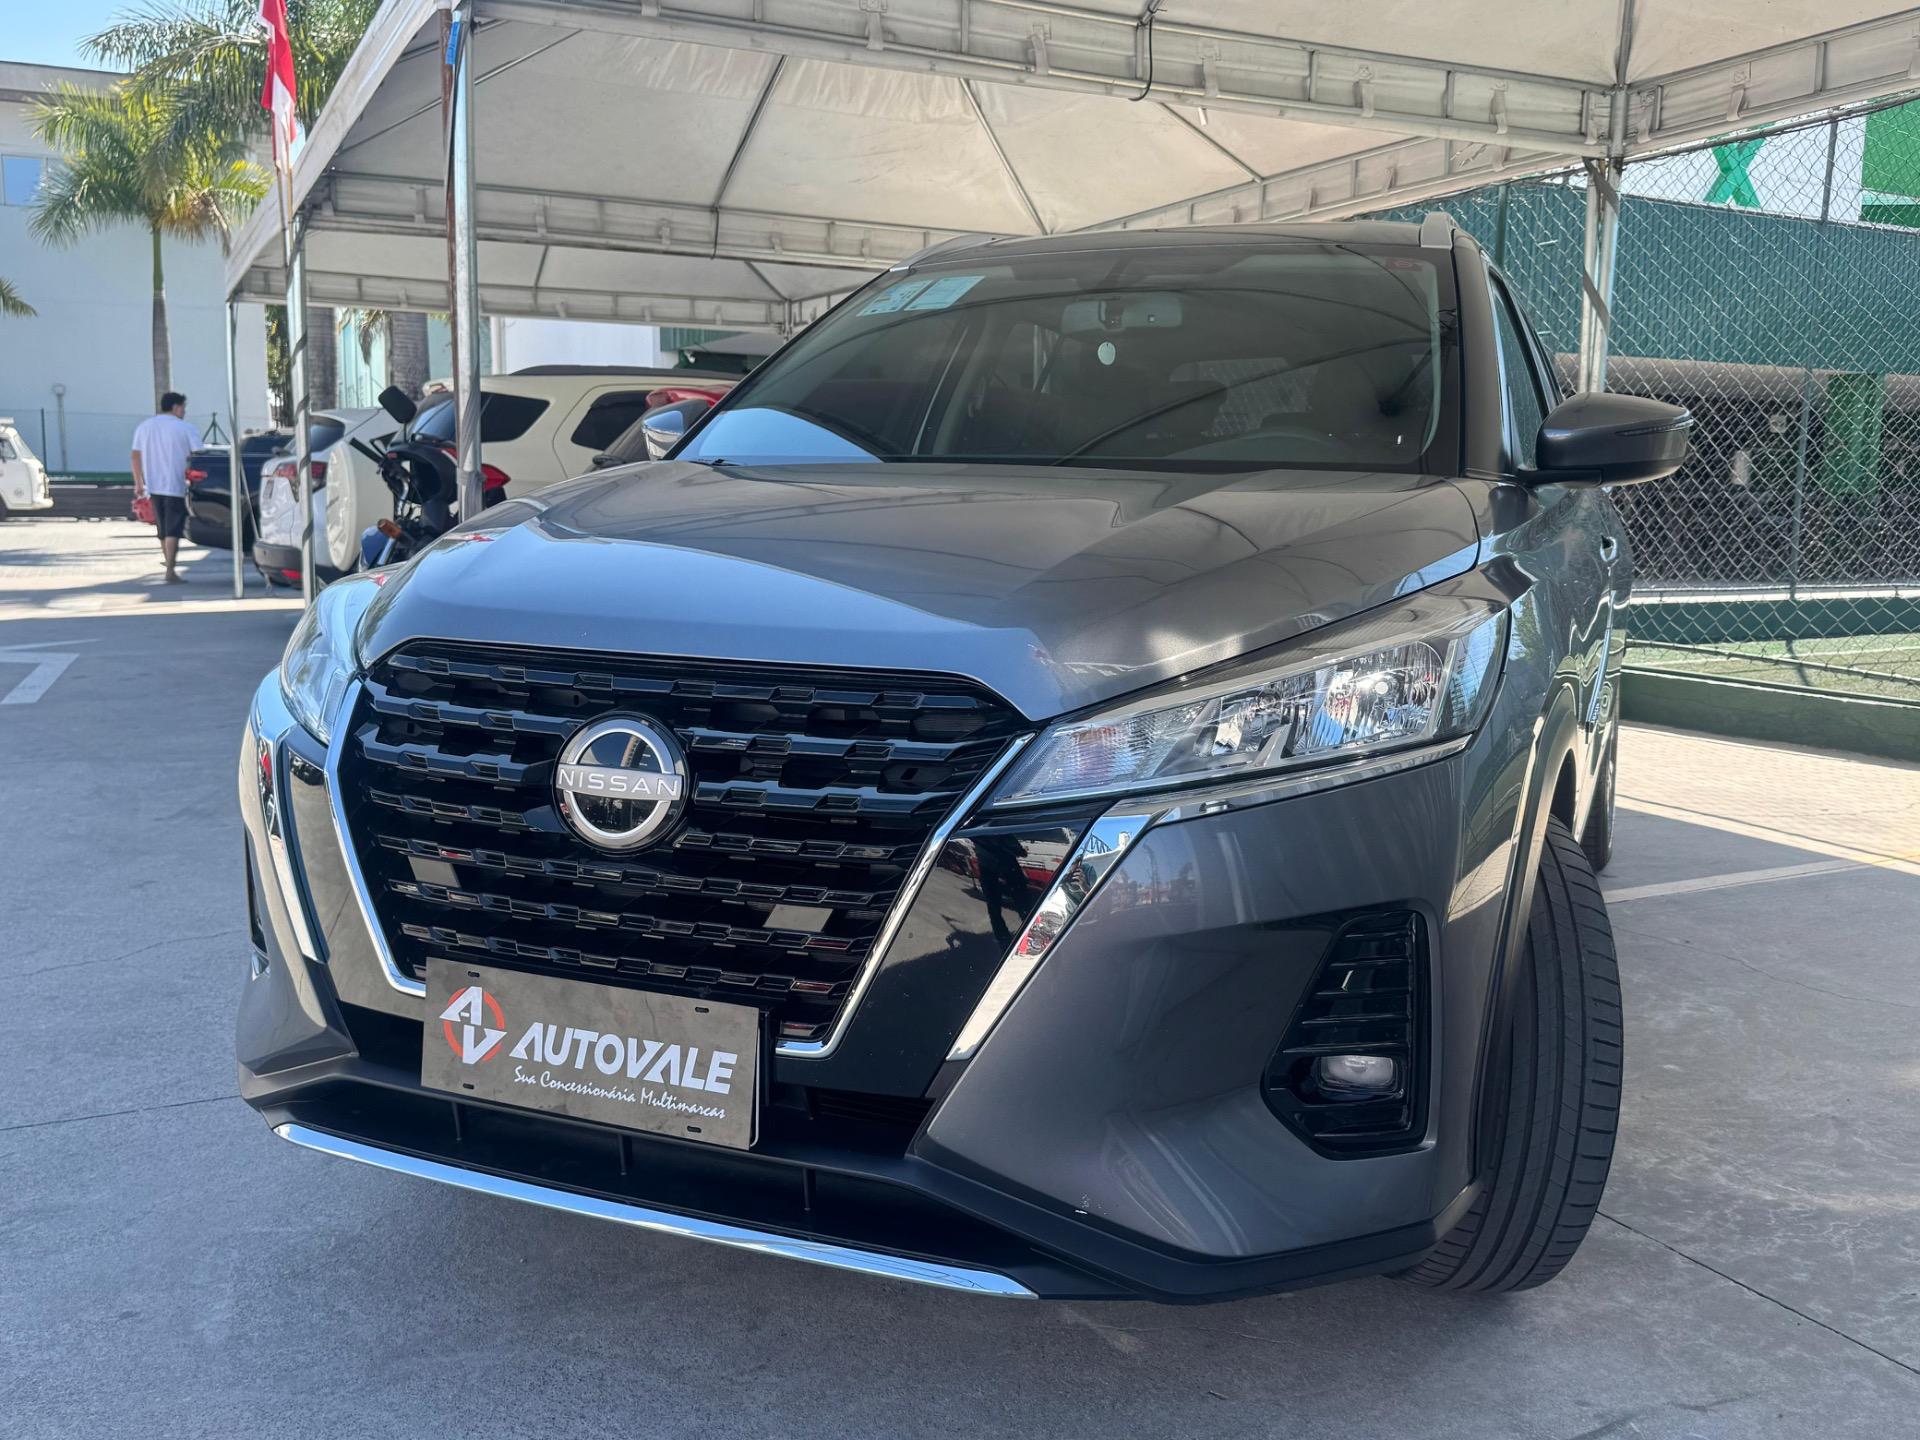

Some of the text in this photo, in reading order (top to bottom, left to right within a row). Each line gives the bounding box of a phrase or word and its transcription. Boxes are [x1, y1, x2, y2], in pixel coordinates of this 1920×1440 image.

[558, 770, 678, 796] NISSAN
[509, 1022, 738, 1094] AUTOVALE
[514, 1065, 726, 1118] Sua Concessionária Multimarcas
